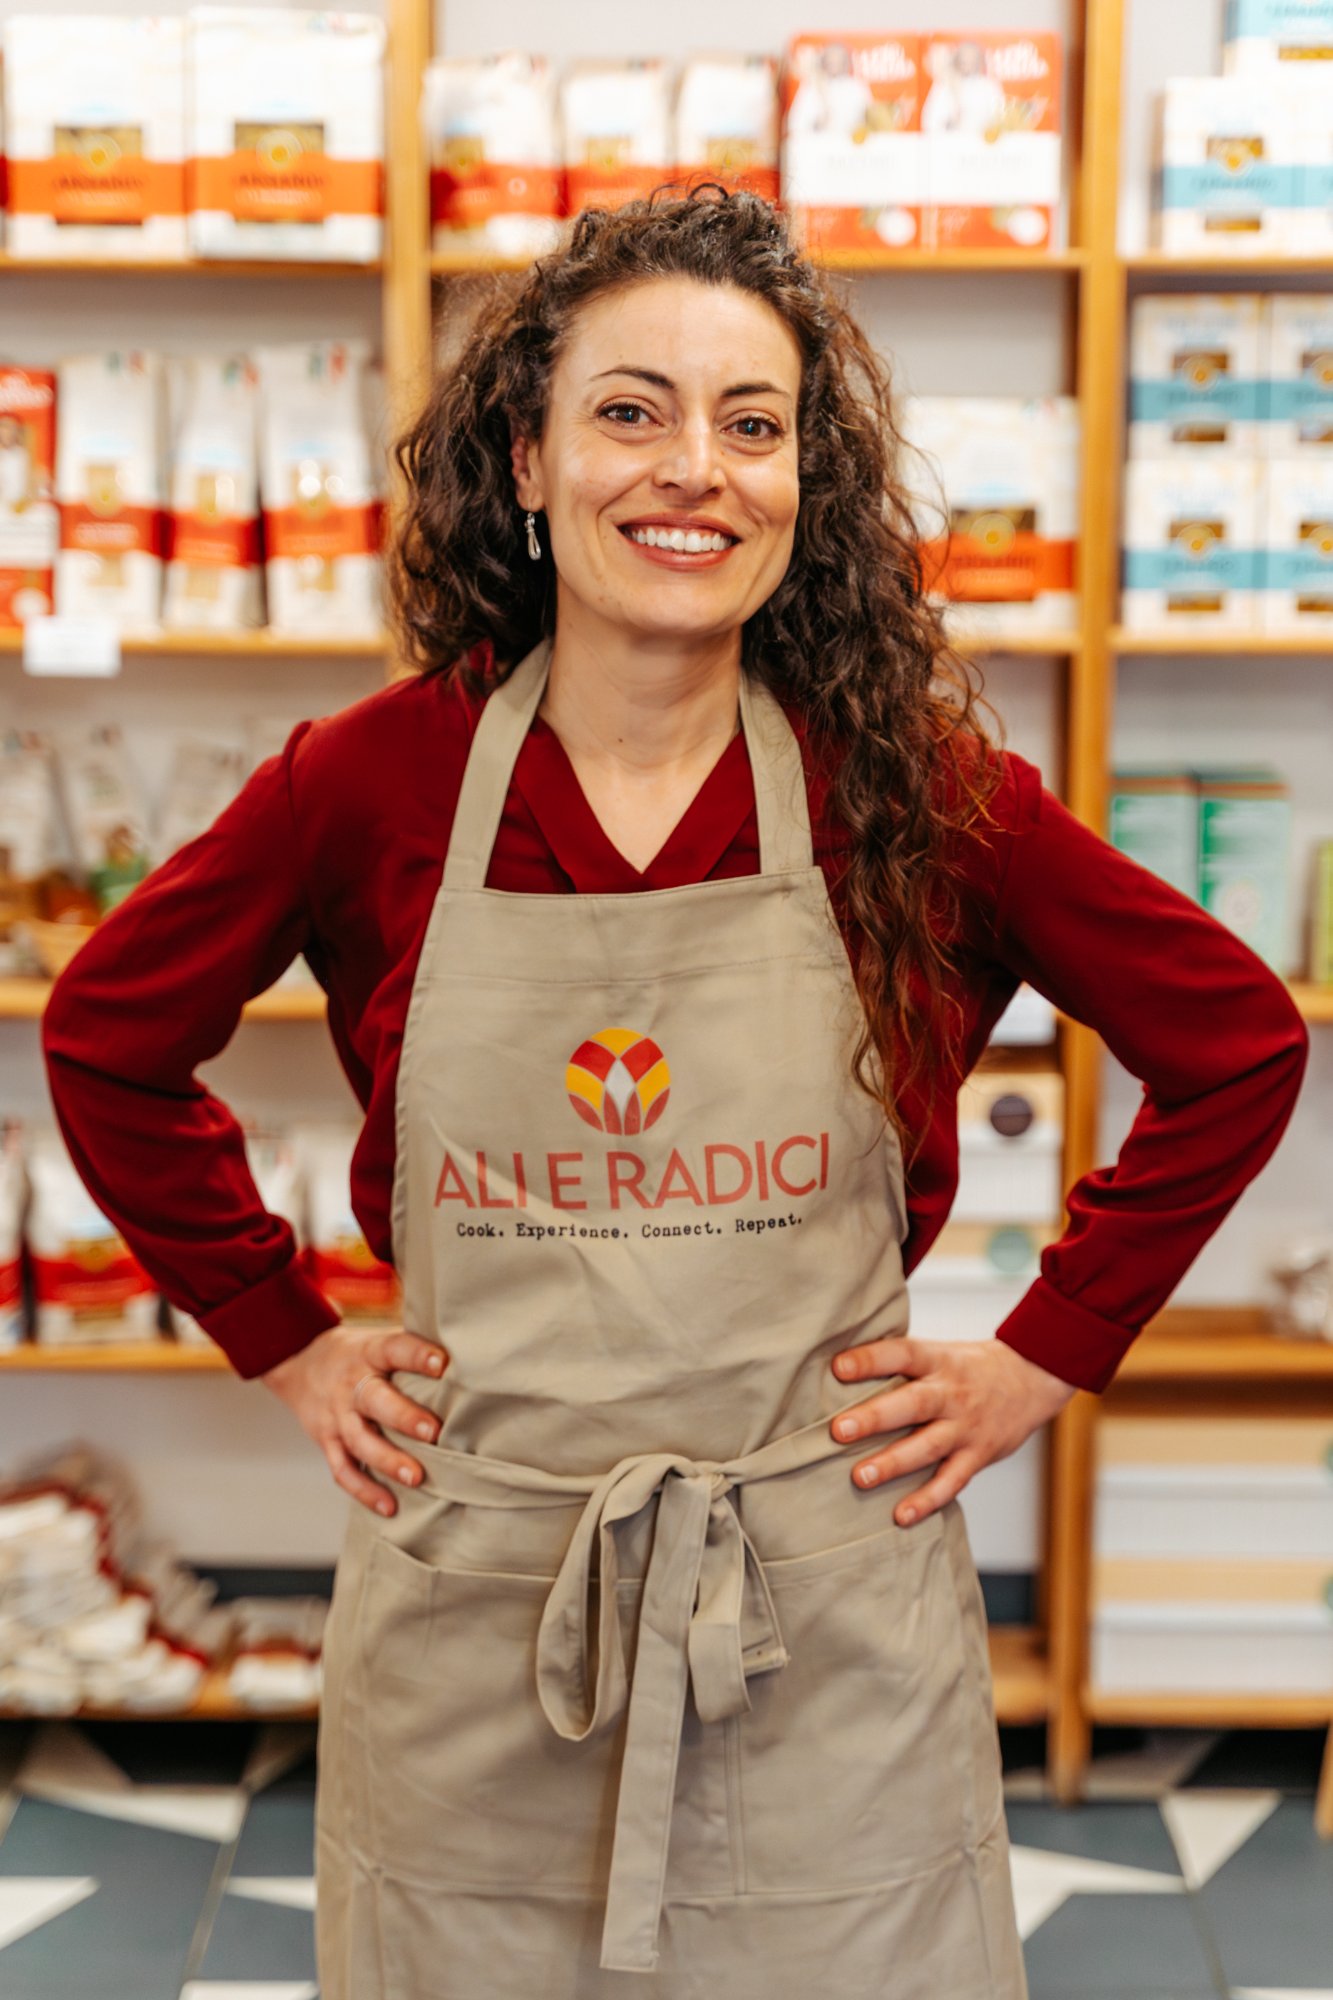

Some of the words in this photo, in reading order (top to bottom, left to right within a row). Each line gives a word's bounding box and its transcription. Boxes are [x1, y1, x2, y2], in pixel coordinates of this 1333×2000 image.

[434, 1150, 528, 1209] ALI
[547, 1152, 588, 1210] E
[606, 1132, 830, 1210] RADICI
[456, 1222, 505, 1239] Cook.
[515, 1222, 629, 1240] Experience.
[641, 1221, 723, 1239] Connect.
[735, 1213, 803, 1236] Repeat.
